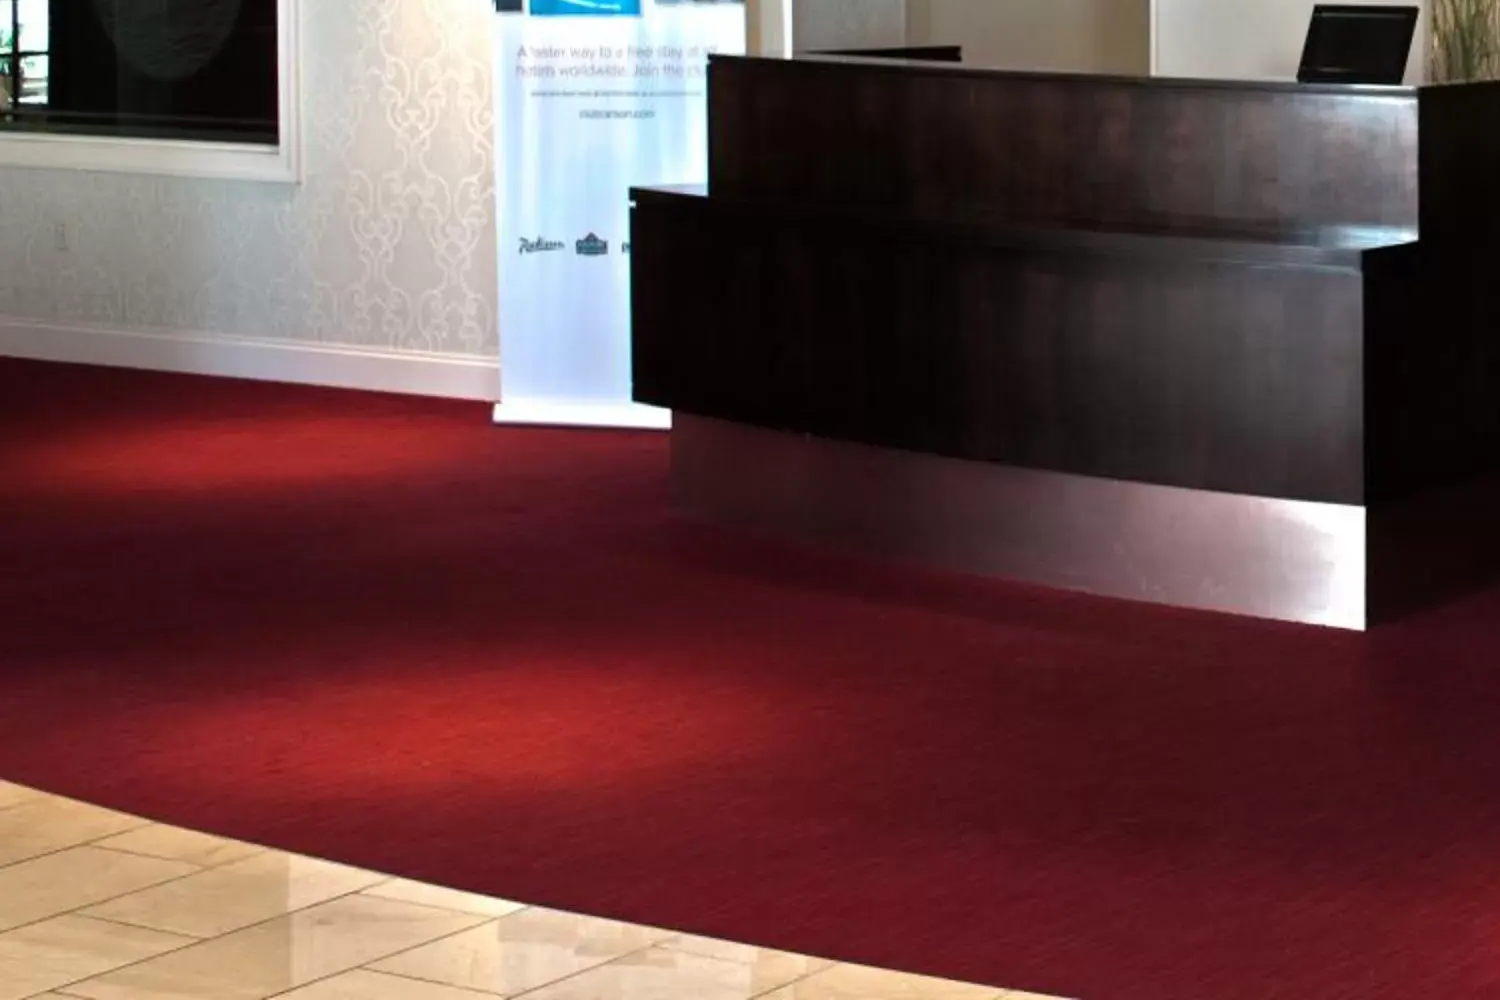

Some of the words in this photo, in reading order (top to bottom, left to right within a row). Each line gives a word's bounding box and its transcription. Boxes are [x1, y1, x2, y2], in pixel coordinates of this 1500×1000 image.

[516, 44, 528, 58] A
[569, 46, 595, 61] way
[599, 44, 612, 58] to
